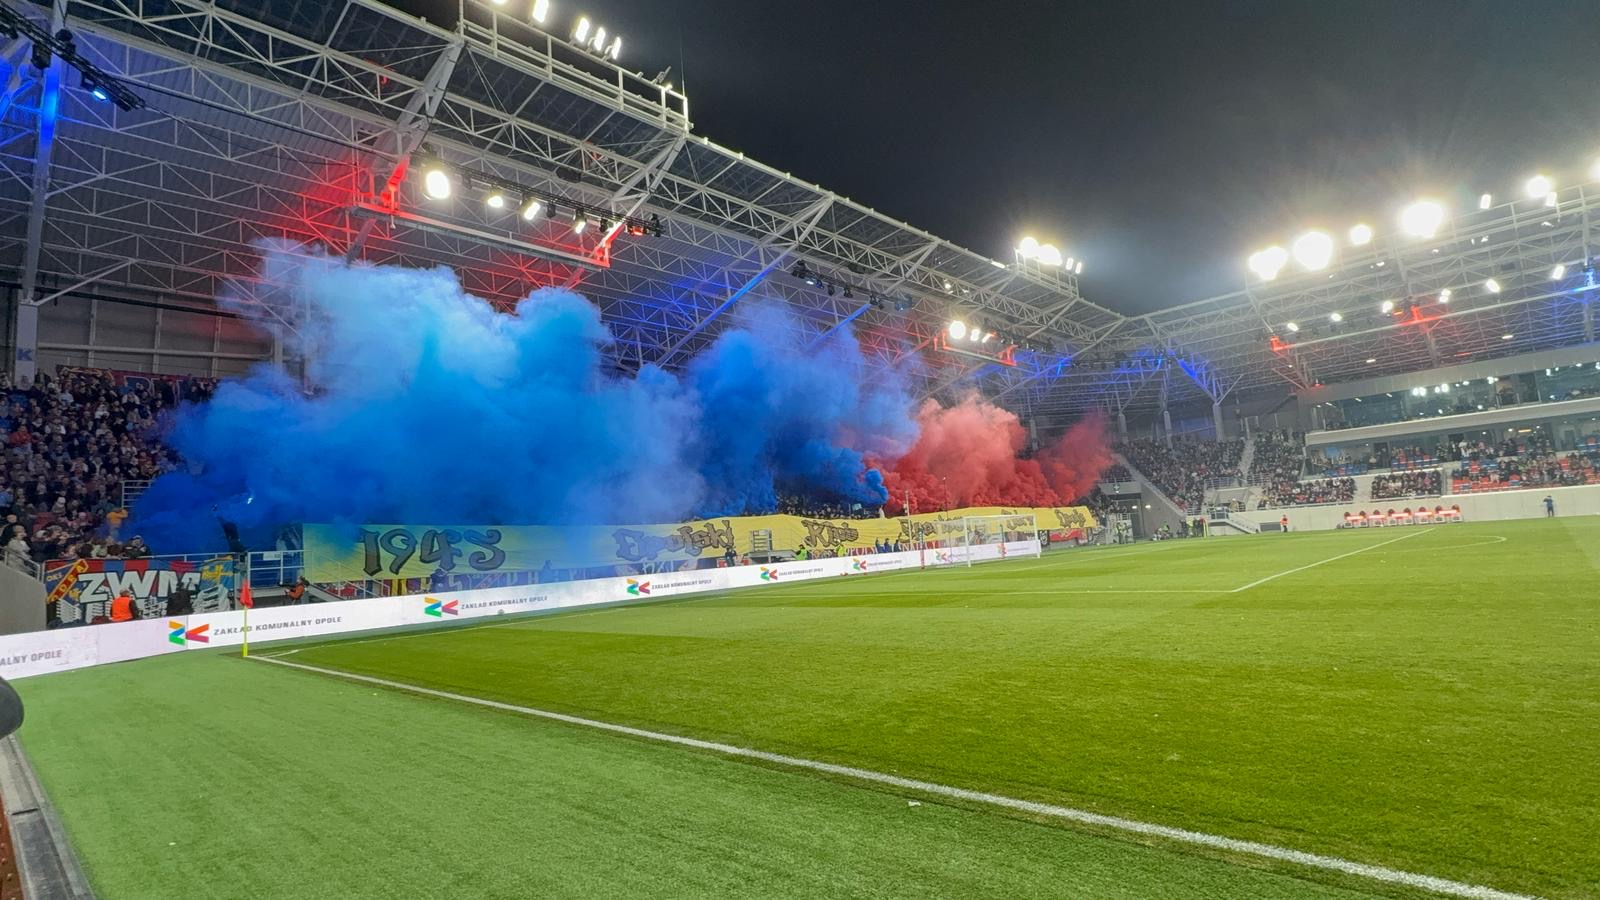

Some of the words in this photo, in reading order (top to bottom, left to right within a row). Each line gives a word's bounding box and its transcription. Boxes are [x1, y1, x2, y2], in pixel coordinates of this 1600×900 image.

[77, 570, 203, 604] ZWM
[255, 619, 312, 631] KOMUNALNY
[315, 616, 342, 625] OPOLE
[0, 655, 28, 666] ALNY
[31, 649, 63, 661] OPOLE
